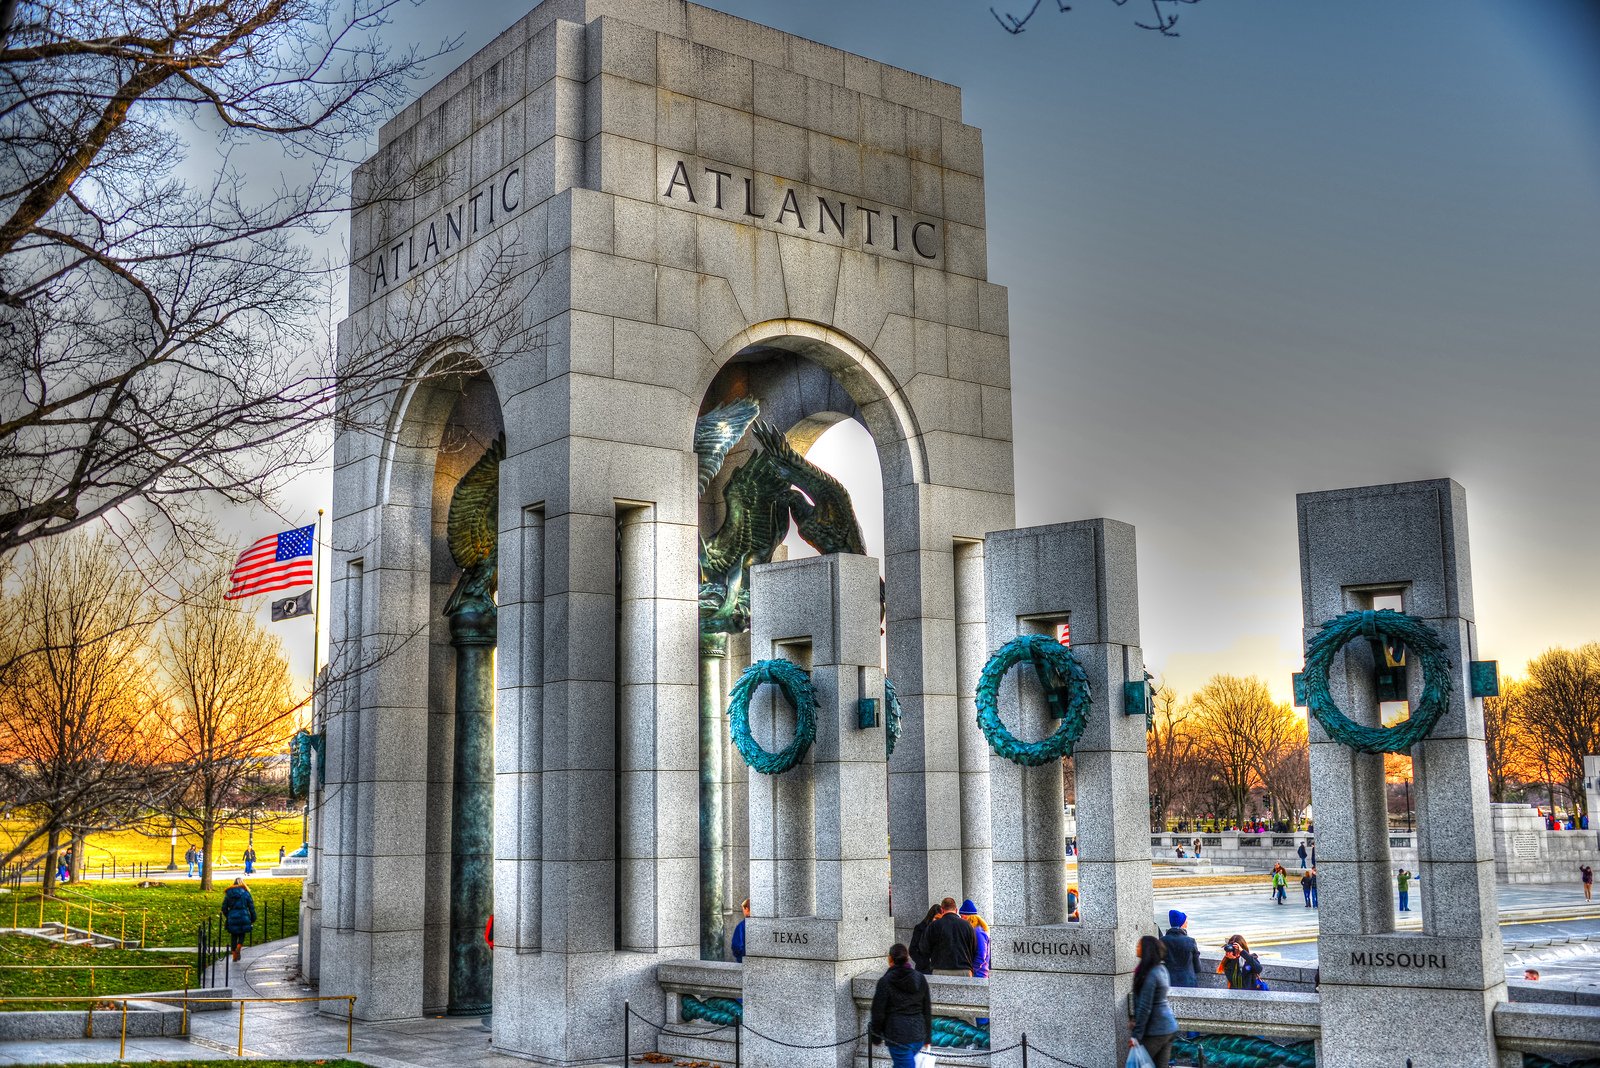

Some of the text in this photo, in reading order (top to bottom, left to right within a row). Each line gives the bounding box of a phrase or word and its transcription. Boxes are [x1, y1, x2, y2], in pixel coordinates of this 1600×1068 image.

[662, 160, 938, 260] ATLANTIC
[372, 168, 519, 294] ATLANTIC
[773, 931, 808, 944] TEXAS
[1013, 941, 1091, 956] MICHIGAN
[1350, 952, 1447, 968] MISSOURI
